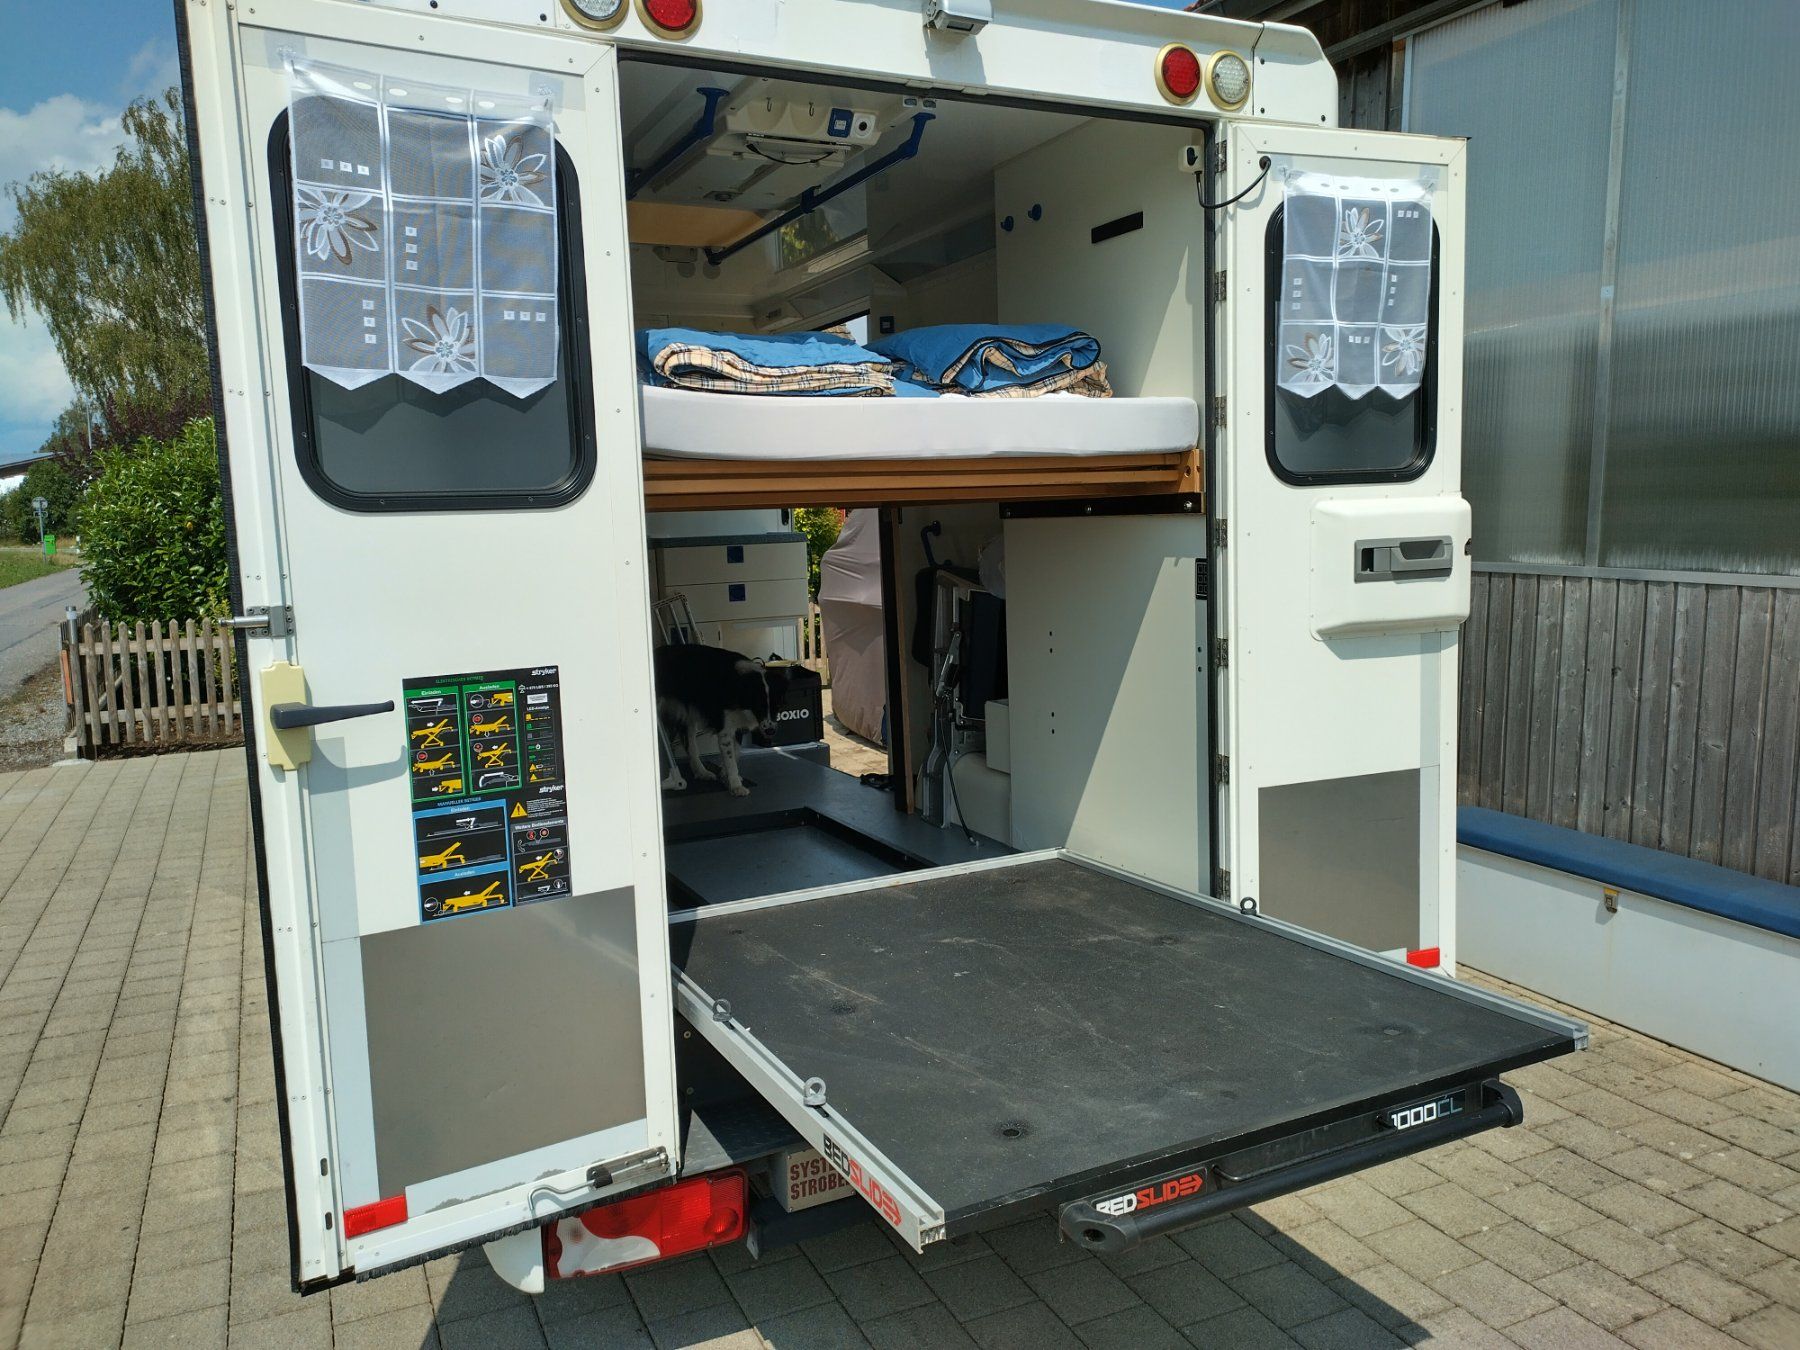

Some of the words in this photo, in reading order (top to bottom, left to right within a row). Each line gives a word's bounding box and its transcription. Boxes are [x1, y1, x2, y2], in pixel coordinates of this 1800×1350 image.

[531, 667, 557, 676] stryker
[539, 784, 565, 794] stryker
[1391, 1097, 1463, 1131] 1000CL
[790, 1172, 850, 1200] STROBE
